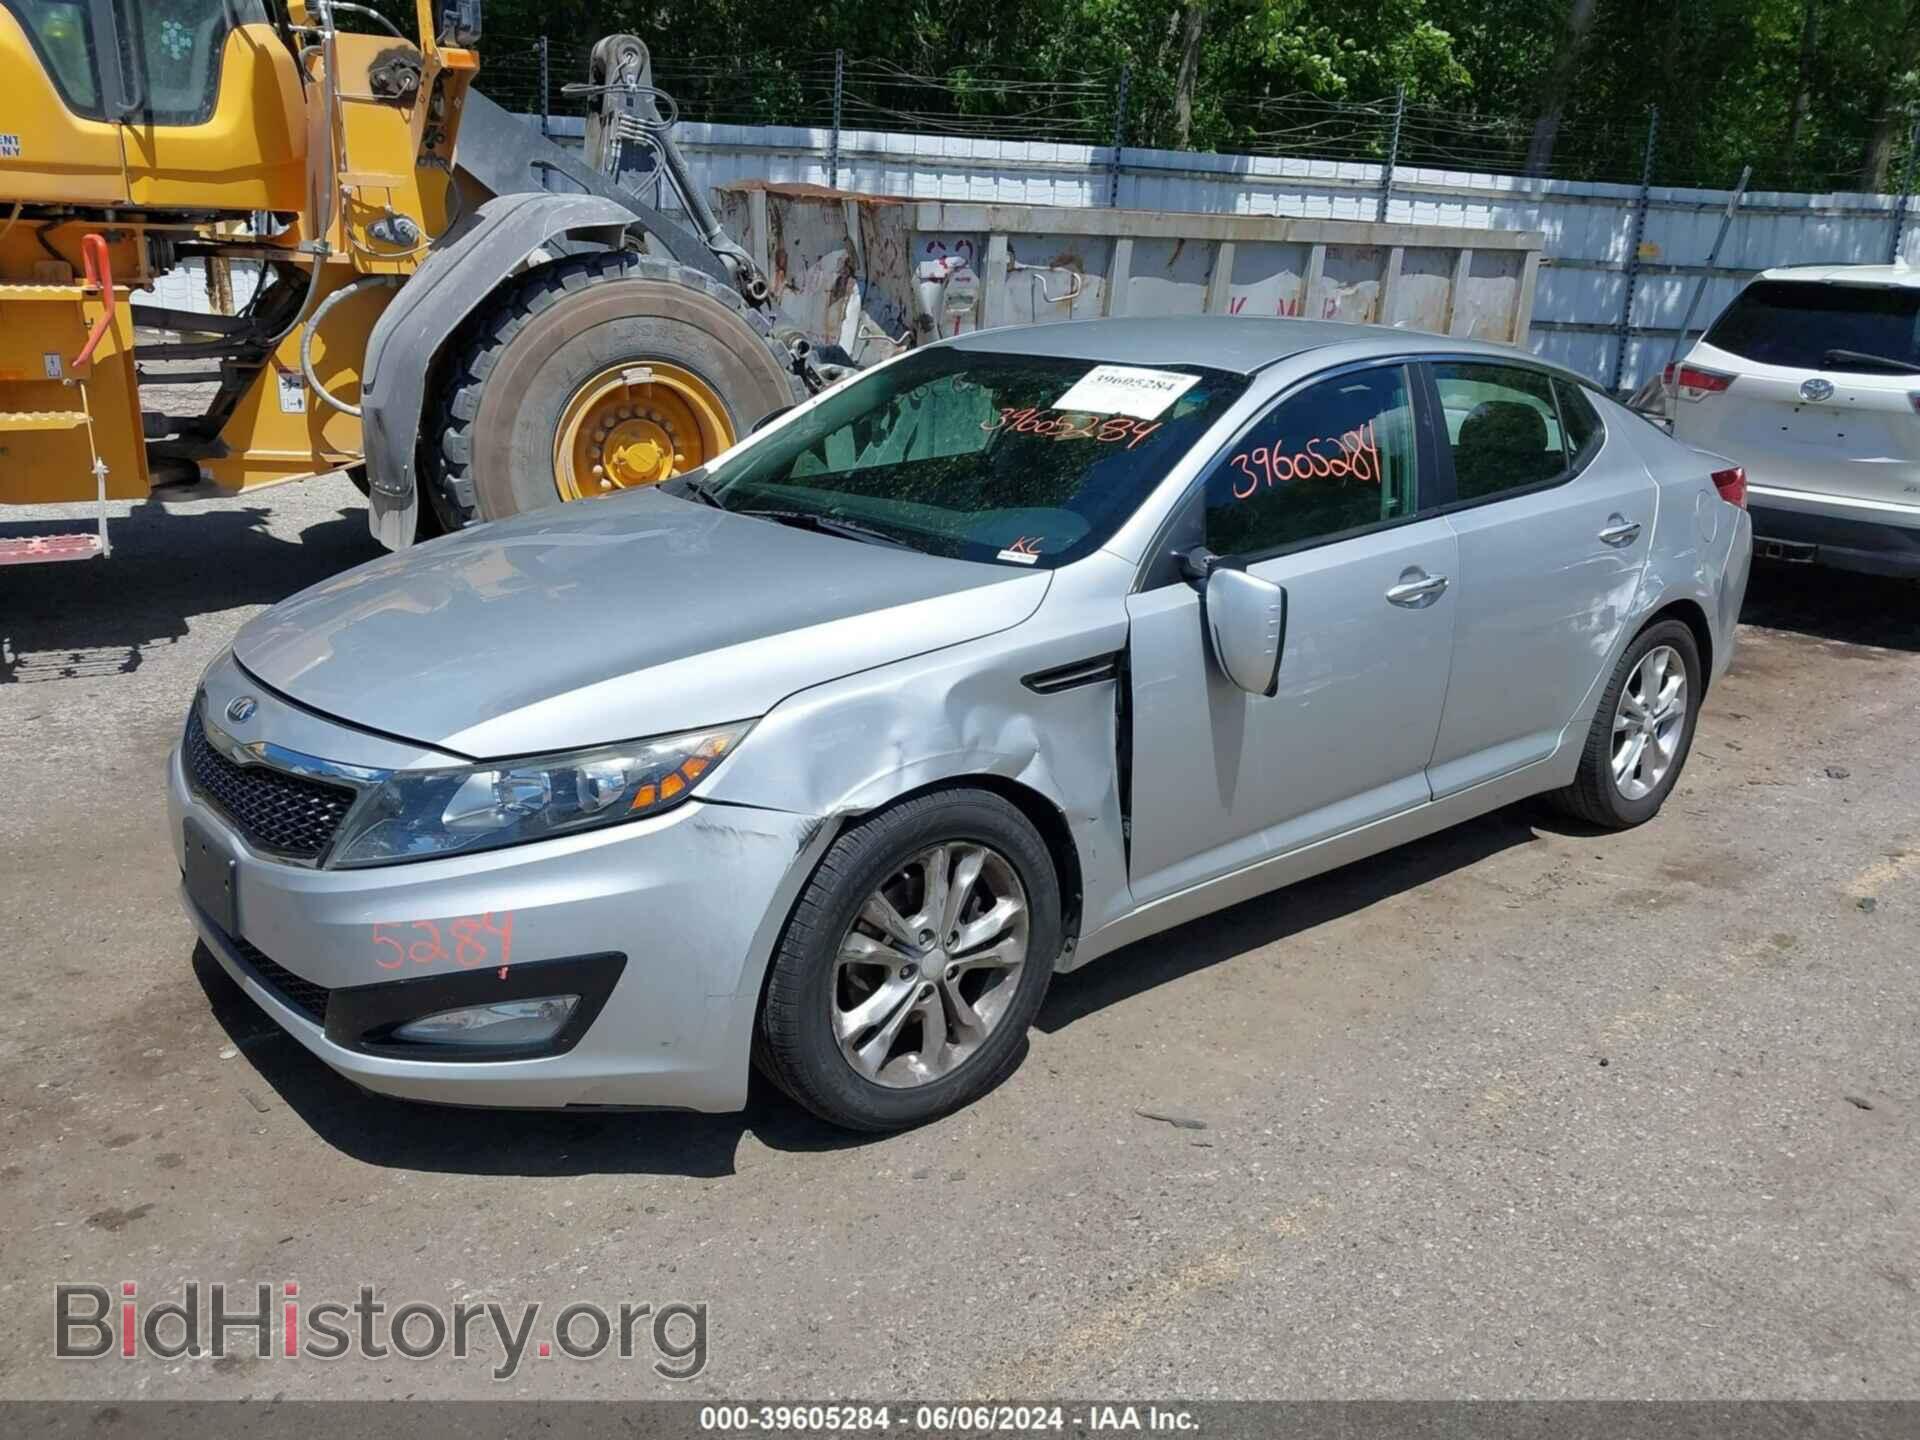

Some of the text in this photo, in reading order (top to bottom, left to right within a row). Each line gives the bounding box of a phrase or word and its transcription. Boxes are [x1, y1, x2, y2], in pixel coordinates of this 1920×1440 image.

[980, 407, 1162, 449] 39605284
[1230, 419, 1381, 498] 39605284
[372, 911, 513, 980] 5284
